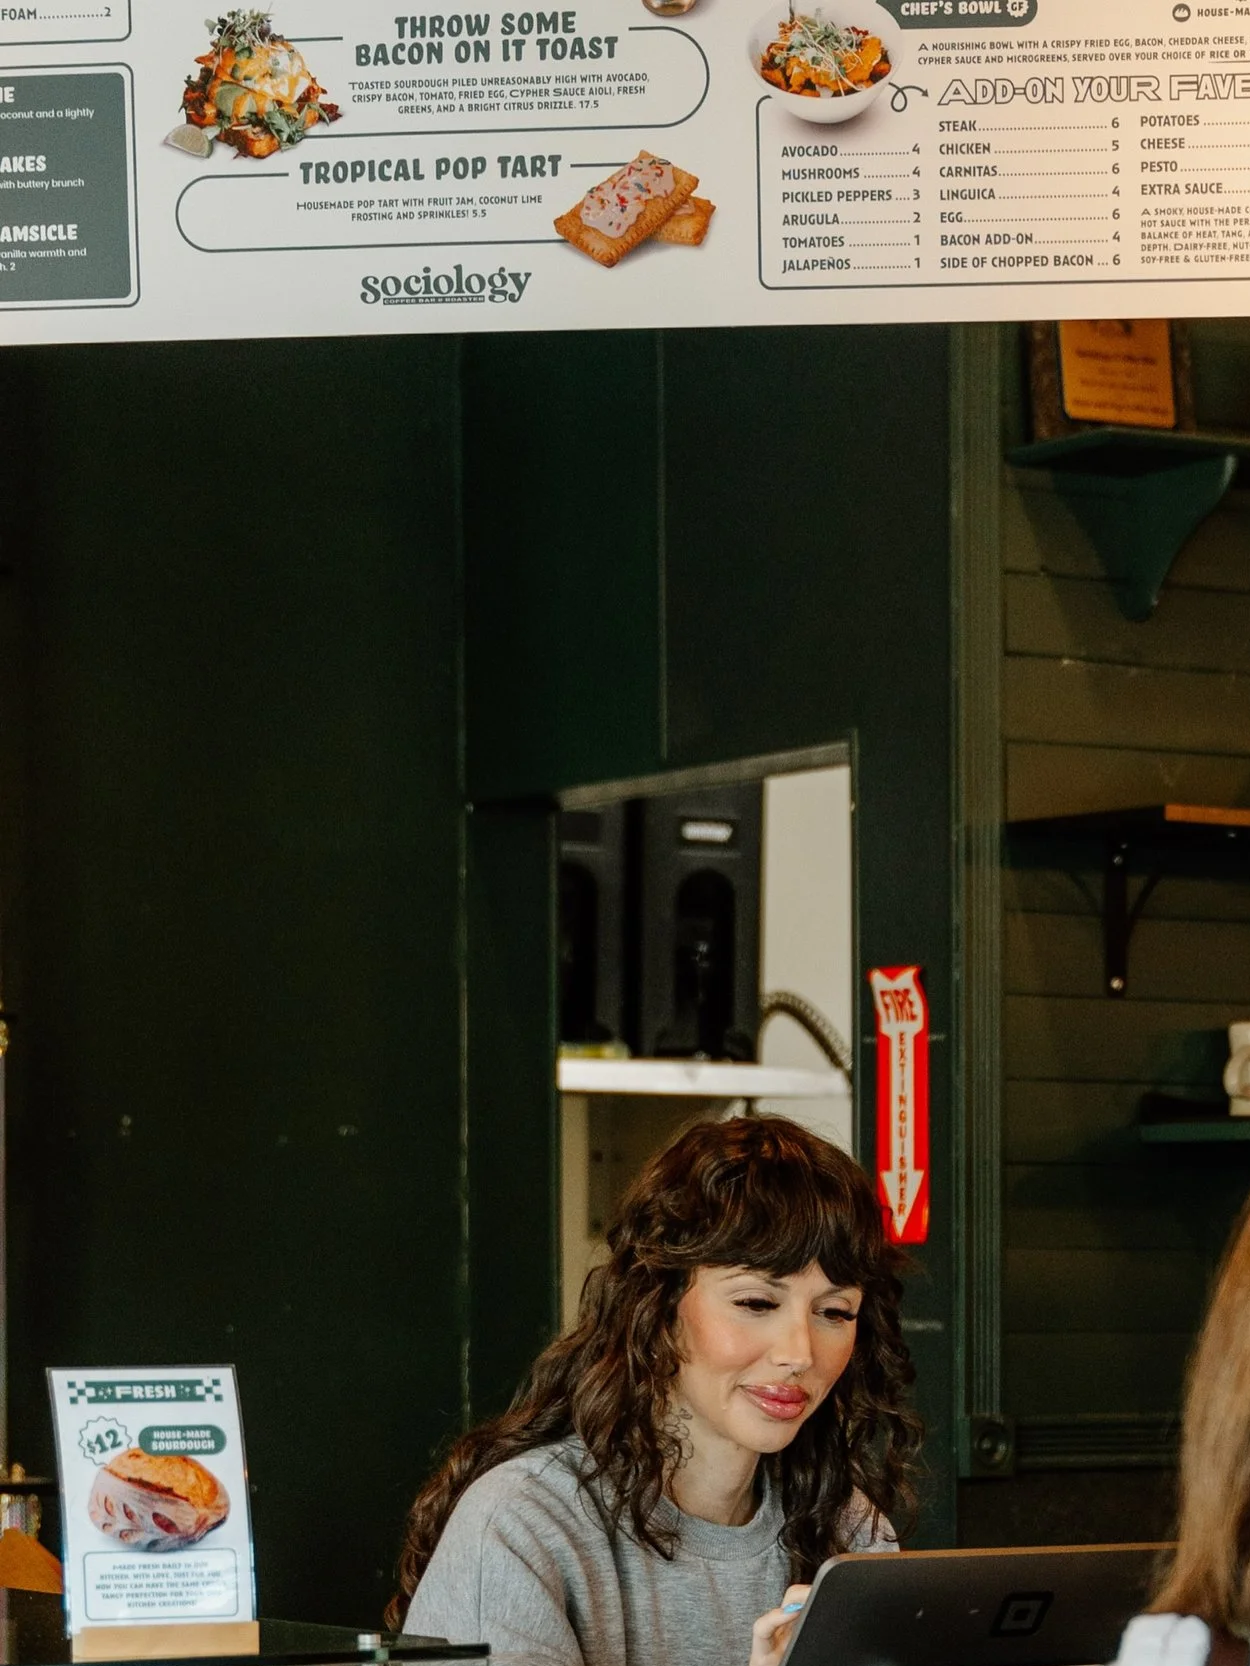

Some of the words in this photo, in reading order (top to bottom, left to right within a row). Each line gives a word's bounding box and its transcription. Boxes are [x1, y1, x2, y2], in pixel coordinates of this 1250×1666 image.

[1, 8, 37, 20] FOAM
[104, 7, 111, 17] 2
[900, 1, 953, 16] CHEF'S
[958, 0, 1002, 15] BOWL
[395, 13, 491, 39] THROW
[500, 11, 577, 35] SOME
[918, 43, 929, 51] A
[932, 42, 987, 51] NOURISHING
[989, 41, 1014, 50] BOWL
[1017, 40, 1039, 49] WITH
[1042, 40, 1048, 49] A
[1051, 39, 1081, 48] CRISPY
[1084, 38, 1111, 47] FRIED
[1113, 38, 1133, 48] EGG,
[1135, 37, 1166, 47] BACON,
[1168, 36, 1210, 46] CHEDDAR
[1212, 35, 1247, 45] CHEESE,
[355, 41, 444, 66] BACON
[454, 40, 491, 63] ON
[502, 39, 526, 62] IT
[536, 36, 619, 61] TOAST
[918, 55, 952, 65] CYPHER
[955, 55, 982, 65] SAUCE
[984, 54, 1004, 64] AND
[1006, 54, 1070, 64] MICROGREENS,
[1072, 53, 1106, 62] SERVED
[1108, 52, 1132, 61] OVER
[1134, 51, 1158, 61] YOUR
[1161, 51, 1192, 60] CHOICE
[1194, 50, 1206, 59] OF
[1209, 50, 1230, 59] RICE
[1233, 49, 1246, 58] OR
[348, 80, 392, 91] TOASTED
[394, 79, 449, 89] SOURDOUGH
[452, 77, 478, 87] PILED
[480, 75, 552, 87] UNREASONABLY
[555, 75, 577, 84] HIGH
[580, 74, 603, 83] WITH
[605, 72, 650, 82] AVOCADO,
[352, 93, 382, 103] CRISPY
[385, 92, 417, 102] BACON,
[419, 91, 456, 101] TOMATO,
[458, 90, 485, 100] FRIED
[488, 90, 508, 99] EGG,
[509, 88, 551, 98] CYPHER
[553, 87, 586, 97] SAUCE
[588, 86, 616, 96] AIOLI,
[617, 85, 646, 95] FRESH
[937, 76, 1065, 106] ADD-ON
[1072, 75, 1162, 103] YOUR
[398, 105, 435, 115] GREENS,
[436, 103, 456, 113] AND
[458, 103, 465, 112] A
[467, 102, 501, 112] BRIGHT
[503, 102, 534, 111] CITRUS
[537, 100, 577, 110] DRIZZLE.
[579, 100, 600, 109] 17.5
[938, 119, 977, 132] STEAK
[1111, 118, 1120, 129] 6
[1140, 114, 1200, 127] POTATOES
[781, 145, 839, 158] AVOCADO
[911, 143, 920, 155] 4
[938, 142, 991, 155] CHICKEN
[1111, 140, 1120, 152] 5
[1140, 137, 1186, 150] CHEESE
[0, 155, 47, 173] AKES
[300, 158, 425, 185] TROPICAL
[435, 156, 487, 181] POP
[497, 154, 562, 179] TART
[939, 165, 998, 178] CARNITAS
[1111, 163, 1120, 175] 6
[1140, 160, 1178, 173] PESTO
[781, 167, 860, 181] MUSHROOMS
[911, 166, 921, 178] 4
[782, 190, 833, 203] PICKLED
[836, 189, 892, 202] PEPPERS
[912, 189, 920, 200] 3
[939, 187, 996, 201] LINGUICA
[1111, 185, 1120, 197] 4
[1140, 183, 1180, 196] EXTRA
[1184, 182, 1223, 195] SAUCE
[296, 200, 354, 211] HOUSEMADE
[357, 199, 375, 209] POP
[378, 198, 400, 208] TART
[402, 198, 424, 207] WITH
[427, 197, 453, 206] FRUIT
[456, 196, 477, 206] JAM,
[479, 195, 519, 205] COCONUT
[521, 194, 543, 204] LIME
[351, 212, 394, 222] FROSTING
[396, 211, 415, 220] AND
[417, 209, 469, 219] SPRINKLES!
[472, 208, 487, 218] 5.5
[939, 211, 964, 224] EGG
[1111, 208, 1120, 220] 6
[1141, 208, 1151, 216] A
[1186, 205, 1242, 215] HOUSE-MADE
[782, 213, 840, 226] ARUGULA
[912, 212, 921, 224] 2
[1140, 219, 1157, 228] HOT
[1160, 219, 1186, 228] SAUCE
[1189, 218, 1211, 227] WITH
[1214, 218, 1230, 226] THE
[0, 224, 78, 242] AMSICLE
[940, 233, 980, 246] BACON
[984, 233, 1033, 245] ADD-ON
[1112, 231, 1121, 243] 4
[1140, 231, 1179, 240] BALANCE
[1182, 230, 1193, 239] OF
[782, 235, 845, 249] TOMATOES
[914, 235, 921, 246] 1
[782, 256, 851, 272] JALAPEÑOS
[914, 257, 921, 269] 1
[940, 256, 968, 269] SIDE
[971, 255, 988, 268] OF
[991, 255, 1049, 268] CHOPPED
[1052, 254, 1094, 267] BACON
[1112, 254, 1121, 266] 6
[360, 263, 532, 304] sociology
[879, 988, 918, 1023] FIRE
[897, 1032, 908, 1216] EXTINGUISHER
[115, 1385, 176, 1399] FRESH
[86, 1428, 123, 1454] $12
[153, 1430, 211, 1439] HOUSE-MADE
[151, 1440, 215, 1451] SOURDOUGH
